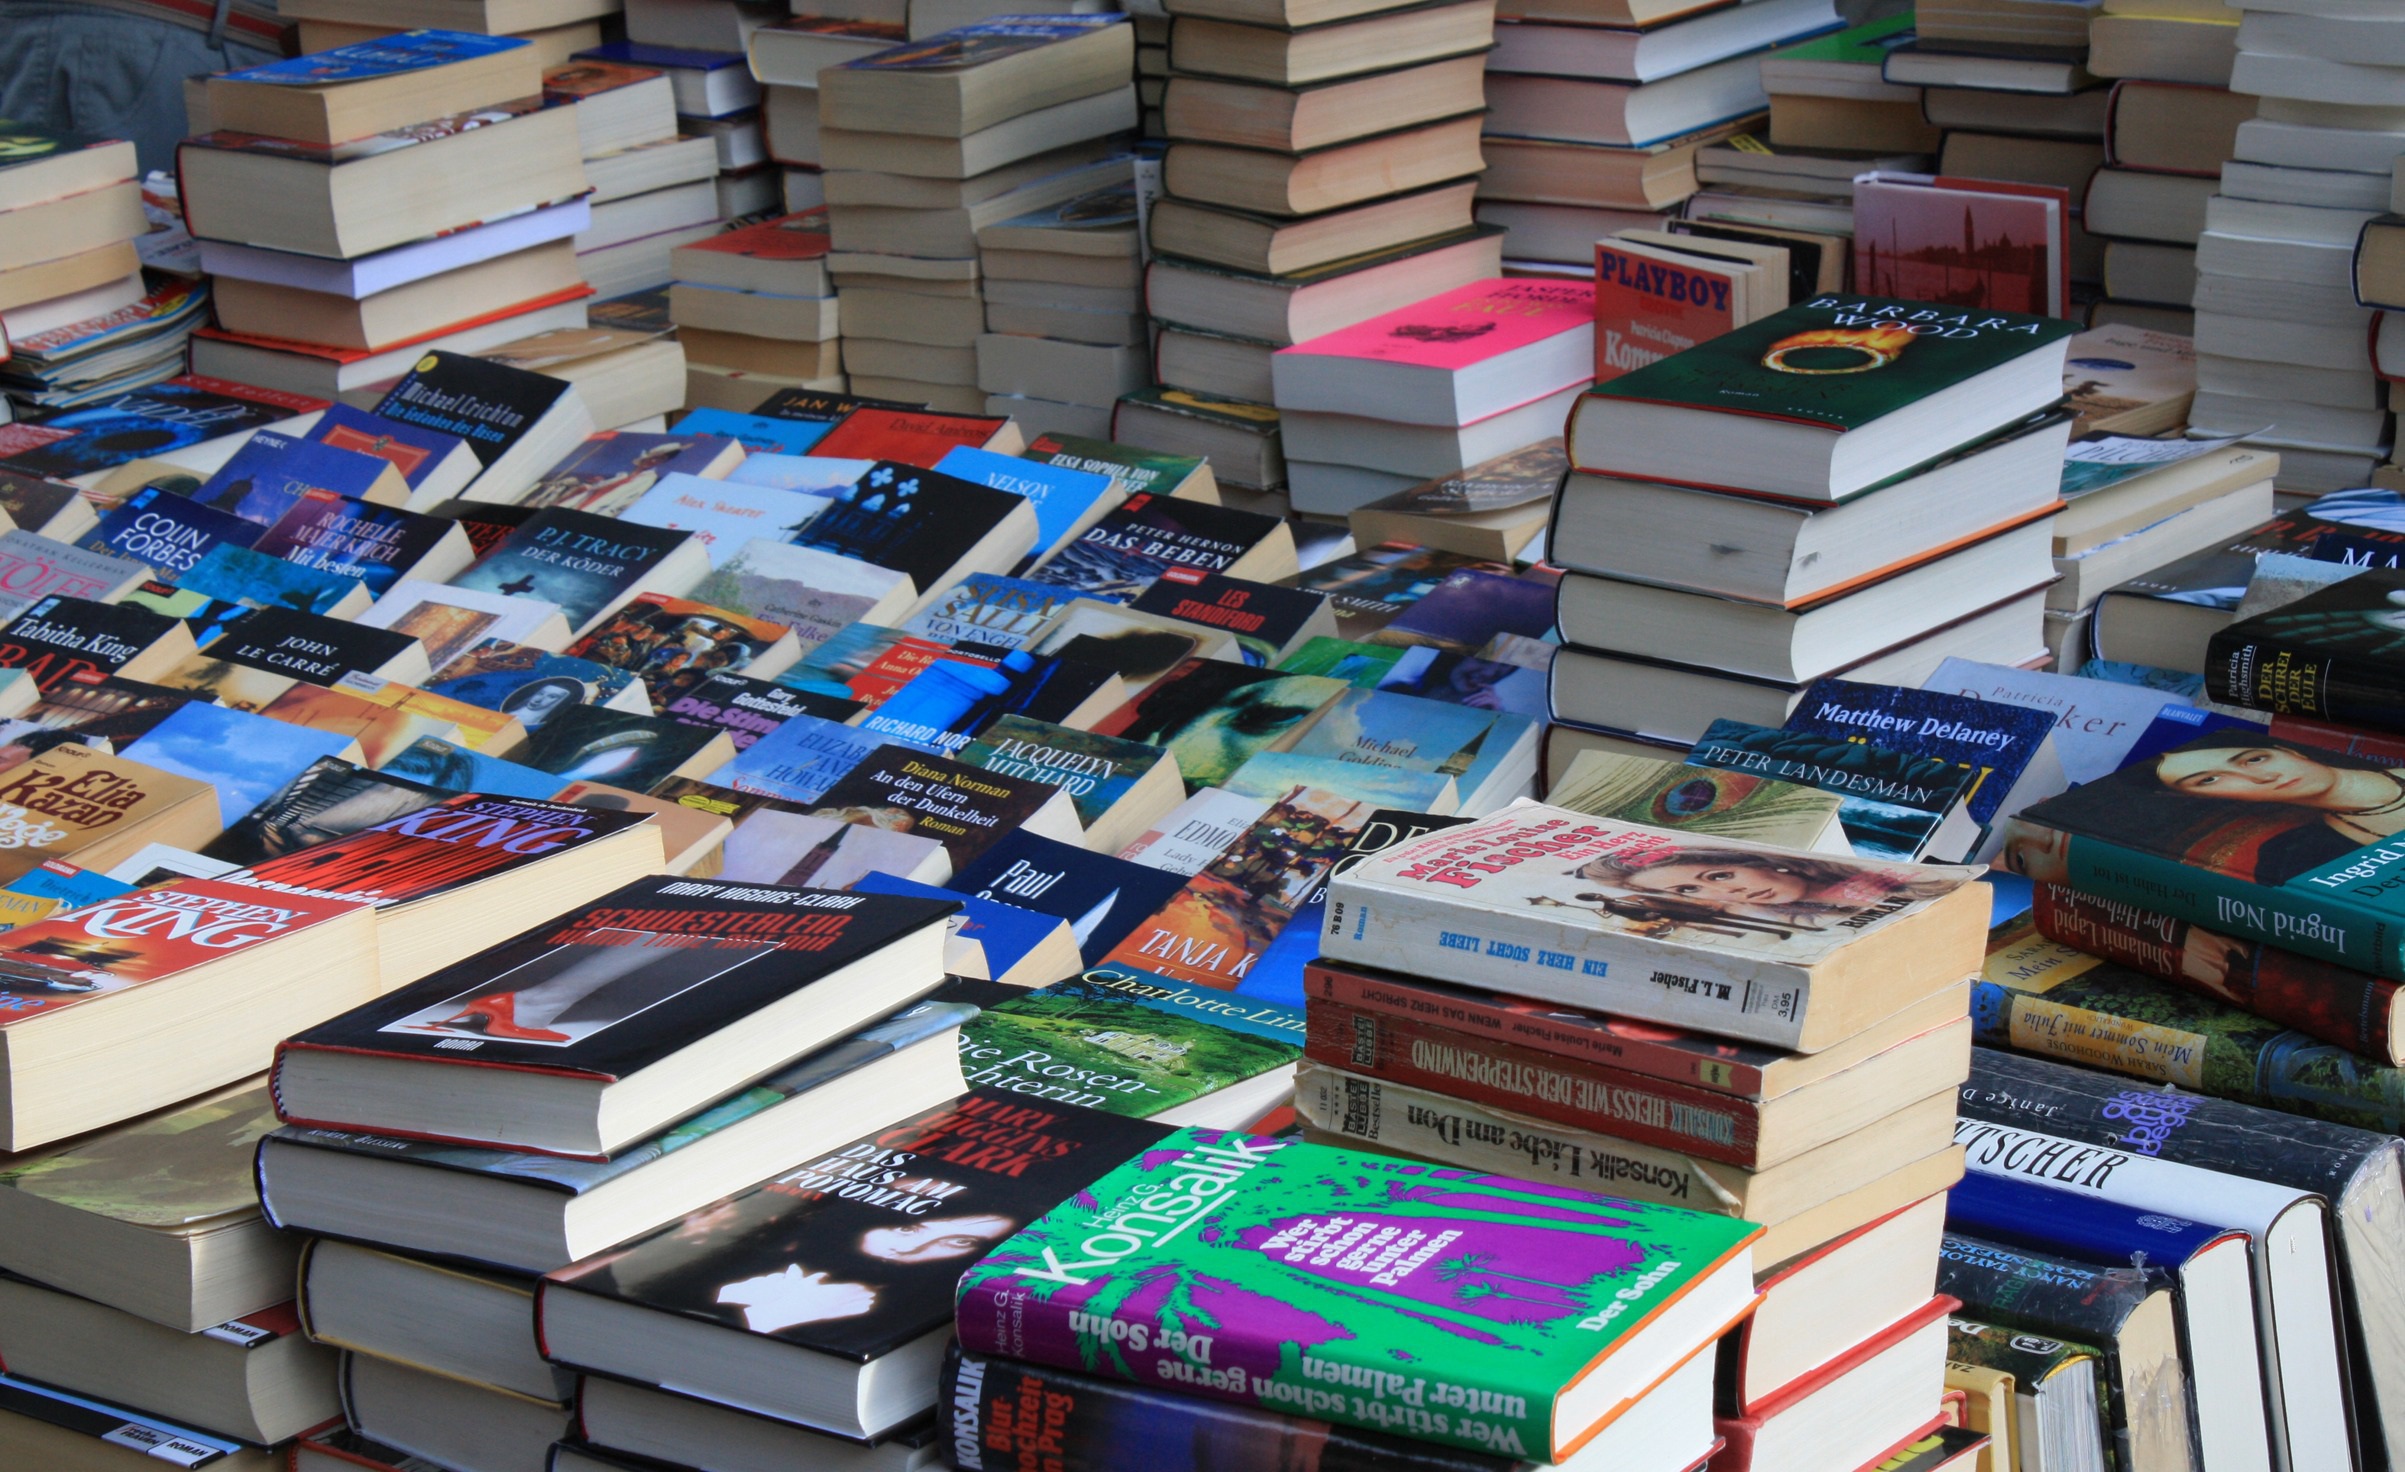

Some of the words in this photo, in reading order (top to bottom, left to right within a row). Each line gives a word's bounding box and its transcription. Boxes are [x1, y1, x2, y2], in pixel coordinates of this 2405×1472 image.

[1600, 250, 1730, 312] PLAYBOY
[1806, 296, 2042, 336] BARBARA
[1831, 312, 1979, 340] WOOD
[400, 380, 466, 417] Michael
[458, 394, 524, 429] Crichton
[782, 396, 829, 411] JAN
[889, 418, 931, 434] David
[979, 471, 1053, 498] NELSON
[1049, 453, 1084, 470] ELSA
[1127, 465, 1161, 483] VON
[134, 513, 211, 551] COLIN
[316, 511, 407, 545] ROCHELLE
[1125, 522, 1176, 541] PETER
[1177, 532, 1246, 556] HERNON
[63, 554, 127, 577] KELLERMAN
[112, 527, 203, 573] FORBES
[281, 543, 317, 568] Mit
[520, 546, 560, 566] DER
[561, 551, 627, 579] KÖDER
[572, 531, 658, 565] TRACY
[1084, 527, 1141, 551] DAS
[1141, 540, 1235, 571] BEBEN
[1170, 599, 1267, 633] STANDIFORD
[1216, 588, 1251, 609] LES
[9, 617, 86, 653] Tabitha
[81, 632, 139, 664] King
[275, 634, 339, 657] JOHN
[235, 644, 260, 659] LE
[265, 652, 341, 678] CARRÉ
[2228, 650, 2240, 699] Patricia
[2241, 644, 2254, 708] Highsmith
[766, 687, 797, 705] Gary
[1991, 684, 2065, 708] Patricia
[2258, 661, 2274, 702] DER
[2274, 649, 2292, 714] SCHREI
[2288, 668, 2303, 705] DER
[2302, 663, 2318, 713] EULE
[865, 714, 941, 742] RICHARD
[1813, 700, 1917, 734] Matthew
[1915, 715, 2017, 752] Delaney
[987, 738, 1123, 781] JACQUELYN
[1352, 734, 1418, 760] Michael
[53, 769, 147, 810] Elia
[869, 768, 894, 785] An
[892, 774, 925, 794] den
[925, 781, 970, 806] Ufern
[901, 760, 949, 785] Diana
[950, 773, 1012, 800] Norman
[1703, 744, 1772, 772] PETER
[1777, 756, 1934, 805] LANDESMAN
[464, 801, 598, 827] STEPHEN
[886, 790, 914, 808] der
[912, 797, 1000, 830] Dunkelheit
[917, 815, 968, 838] Roman
[365, 806, 595, 856] KING
[1162, 848, 1194, 864] Lady
[1395, 843, 1489, 881] Marie
[1425, 824, 1613, 890] Fischer
[1552, 843, 1598, 862] Ein
[2308, 848, 2404, 888] Ingrid
[656, 881, 728, 898] MARY
[988, 858, 1067, 900] Paul
[47, 898, 293, 949] KING
[130, 890, 314, 924] STEPHEN
[1333, 913, 1343, 923] B
[1335, 902, 1345, 914] 09
[1354, 906, 1368, 941] Roman
[1835, 894, 1917, 929] ROMAN
[2216, 894, 2268, 933] Noll
[2272, 911, 2347, 955] Ingrid
[1330, 923, 1341, 935] 76
[1438, 930, 1481, 953] LIEBE
[1138, 928, 1231, 972] TANJA
[1486, 939, 1532, 962] SUCHT
[1536, 949, 1576, 972] HERZ
[1582, 961, 1609, 978] EIN
[1649, 971, 1701, 995] Fischer
[1080, 969, 1249, 1018] Charlotte
[1360, 988, 1408, 1009] SPRICHT
[1410, 998, 1441, 1016] HERZ
[1713, 984, 1732, 1001] M.
[1778, 991, 1792, 1018] 3,95
[1442, 1006, 1466, 1022] DAS
[1467, 1012, 1503, 1030] WENN
[2022, 1011, 2054, 1036] Julia
[2055, 1020, 2079, 1039] mit
[433, 1038, 486, 1052] ROMAN
[1511, 1022, 1551, 1042] Fischer
[1554, 1031, 1591, 1050] Louise
[1592, 1040, 1624, 1058] Marie
[2080, 1026, 2149, 1055] Sommer
[1411, 1039, 1536, 1095] STEPPENWIND
[2126, 1058, 2167, 1077] SARAH
[2150, 1040, 2194, 1066] Mein
[999, 1049, 1163, 1096] Rosen-
[1537, 1068, 1574, 1102] DER
[1347, 1079, 1359, 1132] BASTEI
[1575, 1078, 1609, 1112] WIE
[1610, 1087, 1667, 1130] HEISS
[955, 1096, 1060, 1132] MARY
[1406, 1103, 1462, 1148] Don
[875, 1125, 1042, 1178] CLARK
[914, 1110, 1083, 1159] HIGGINS
[1464, 1121, 1507, 1148] am
[838, 1142, 918, 1169] DAS
[1508, 1130, 1583, 1180] Liebe
[806, 1156, 906, 1185] HAUS
[893, 1176, 971, 1200] AM
[1589, 1148, 1690, 1199] Konsalik
[775, 1169, 944, 1217] POTOMAC
[1082, 1191, 1140, 1230] Heinz
[1130, 1180, 1164, 1199] G.
[1013, 1136, 1288, 1287] Konsalik
[1259, 1217, 1320, 1252] Wer
[1284, 1216, 1355, 1263] stirbt
[1308, 1221, 1380, 1267] schon
[1335, 1224, 1402, 1274] gerne
[1360, 1228, 1428, 1278] unter
[1575, 1299, 1630, 1333] Der
[1614, 1260, 1683, 1304] Sohn
[2017, 1269, 2087, 1290] NANCY
[993, 1288, 1009, 1308] G.
[217, 1323, 260, 1339] ROMAN
[994, 1308, 1009, 1358] Heinz
[1009, 1290, 1026, 1359] Konsalik
[1068, 1309, 1150, 1352] Sohn
[1152, 1331, 1215, 1365] Der
[1156, 1358, 1248, 1394] gerne
[1300, 1354, 1427, 1403] Palmen
[1252, 1376, 1347, 1415] schon
[1434, 1380, 1527, 1421] unter
[953, 1356, 987, 1471] KONSALIK
[1353, 1397, 1449, 1436] stirbt
[120, 1430, 162, 1447] FRAUEN
[166, 1441, 209, 1457] ROMAN
[1460, 1418, 1530, 1457] Wer
